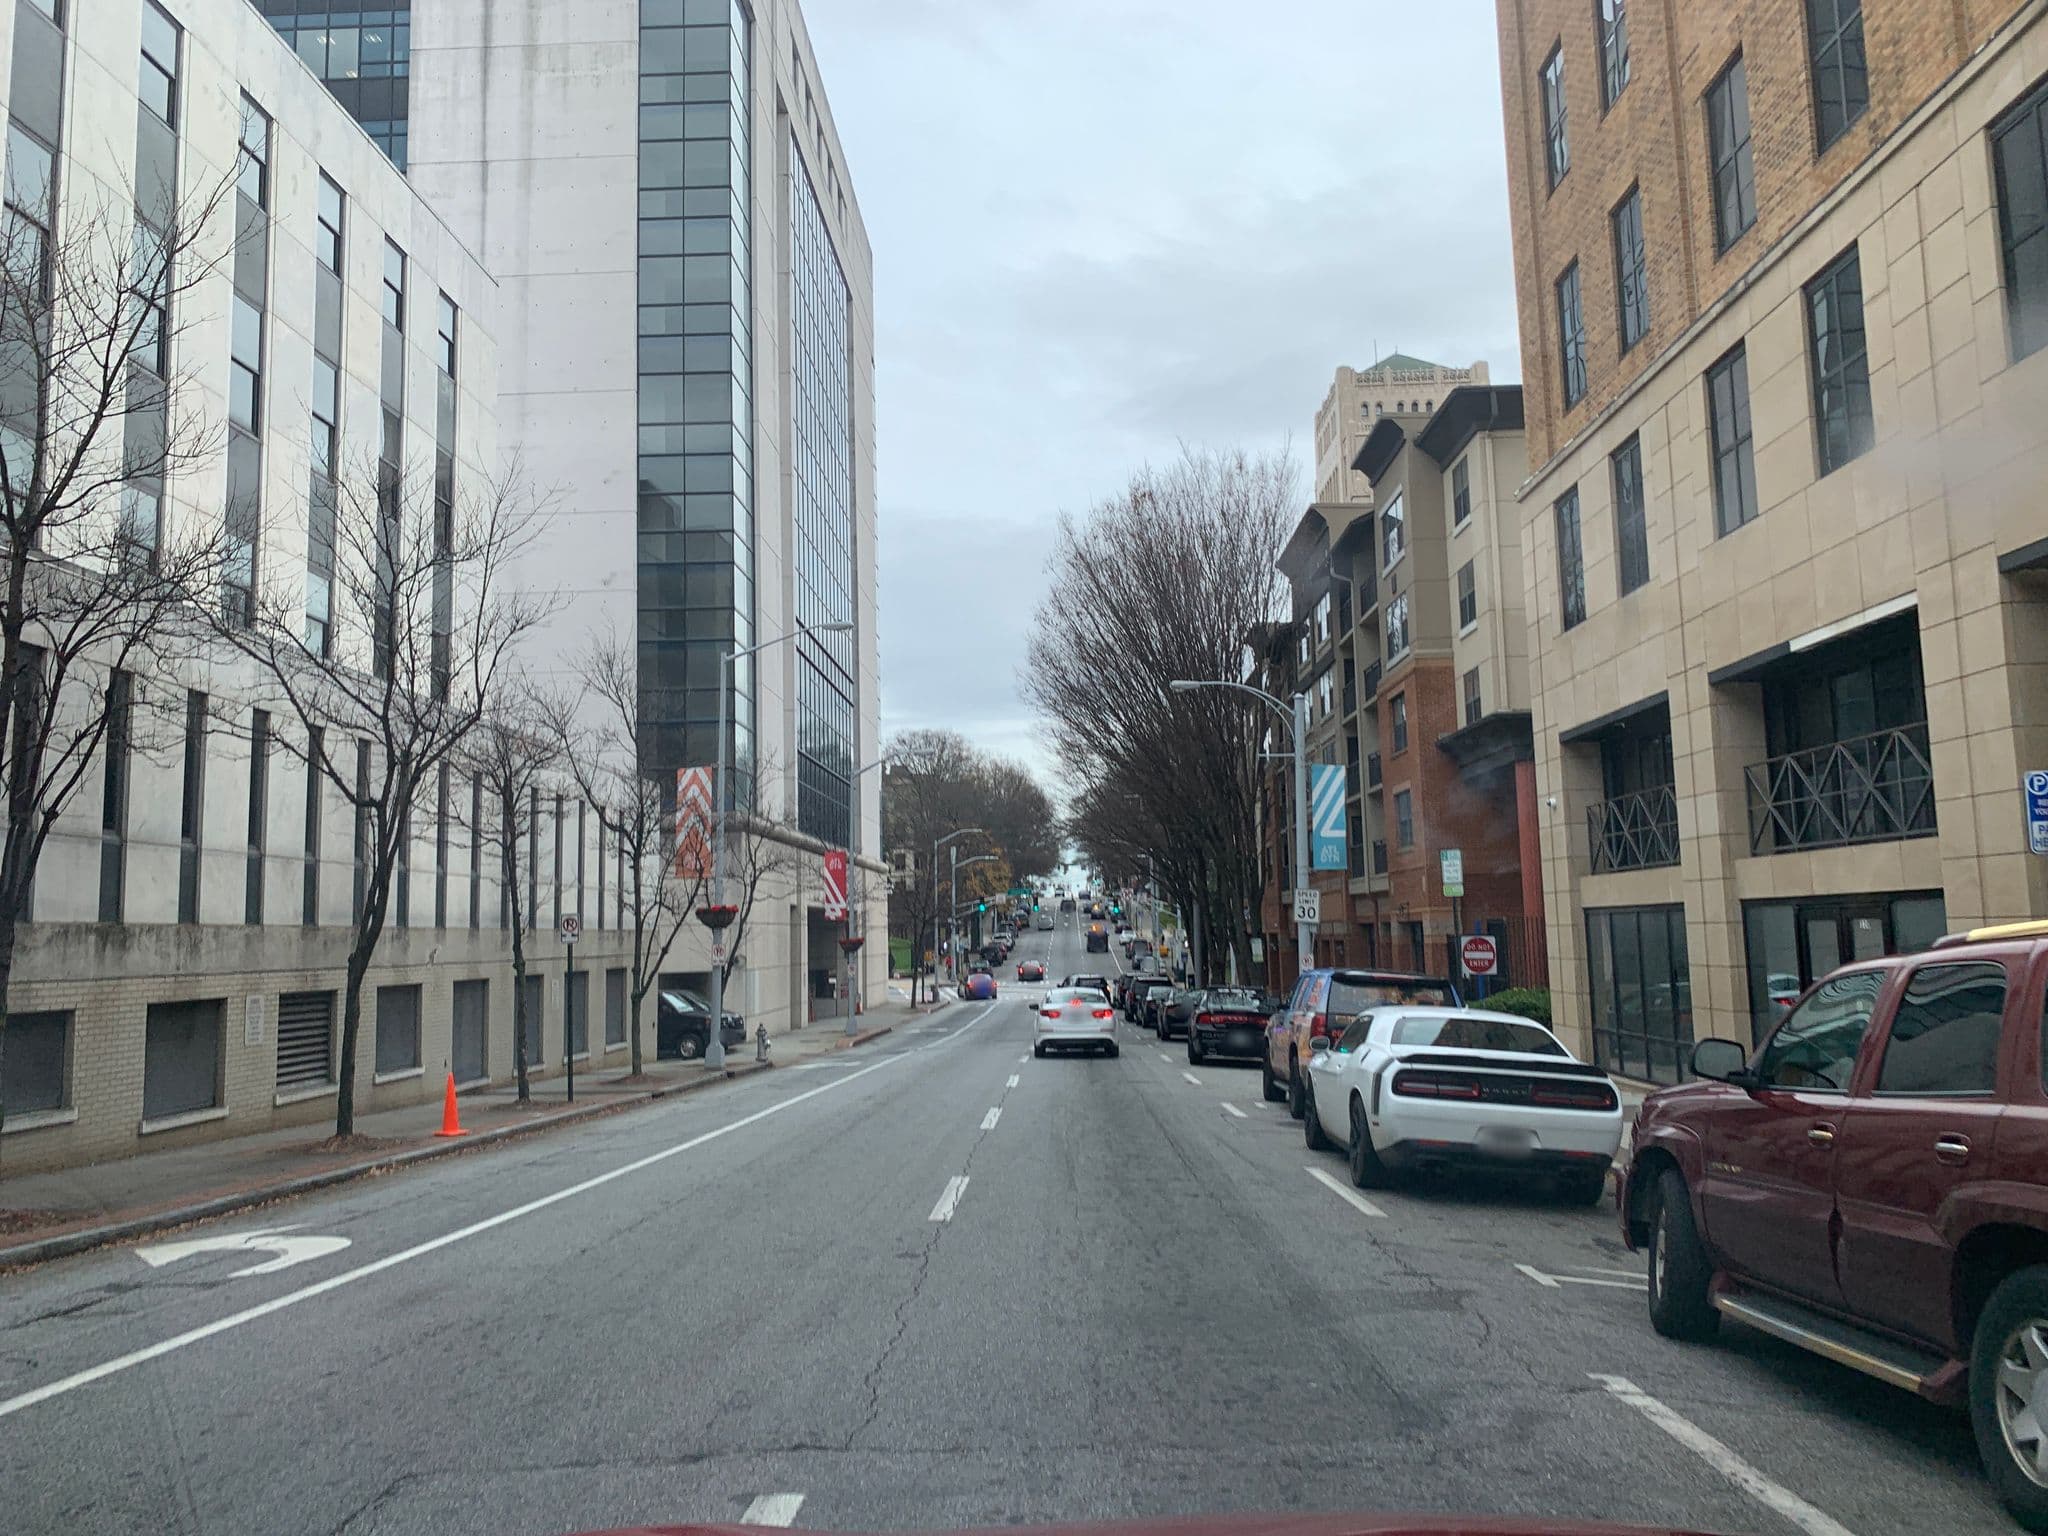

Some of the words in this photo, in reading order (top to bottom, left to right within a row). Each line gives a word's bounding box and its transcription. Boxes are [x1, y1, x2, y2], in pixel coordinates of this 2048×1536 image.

[1297, 906, 1316, 919] 30
[1478, 943, 1490, 951] NOT
[1470, 959, 1489, 968] ENTER
